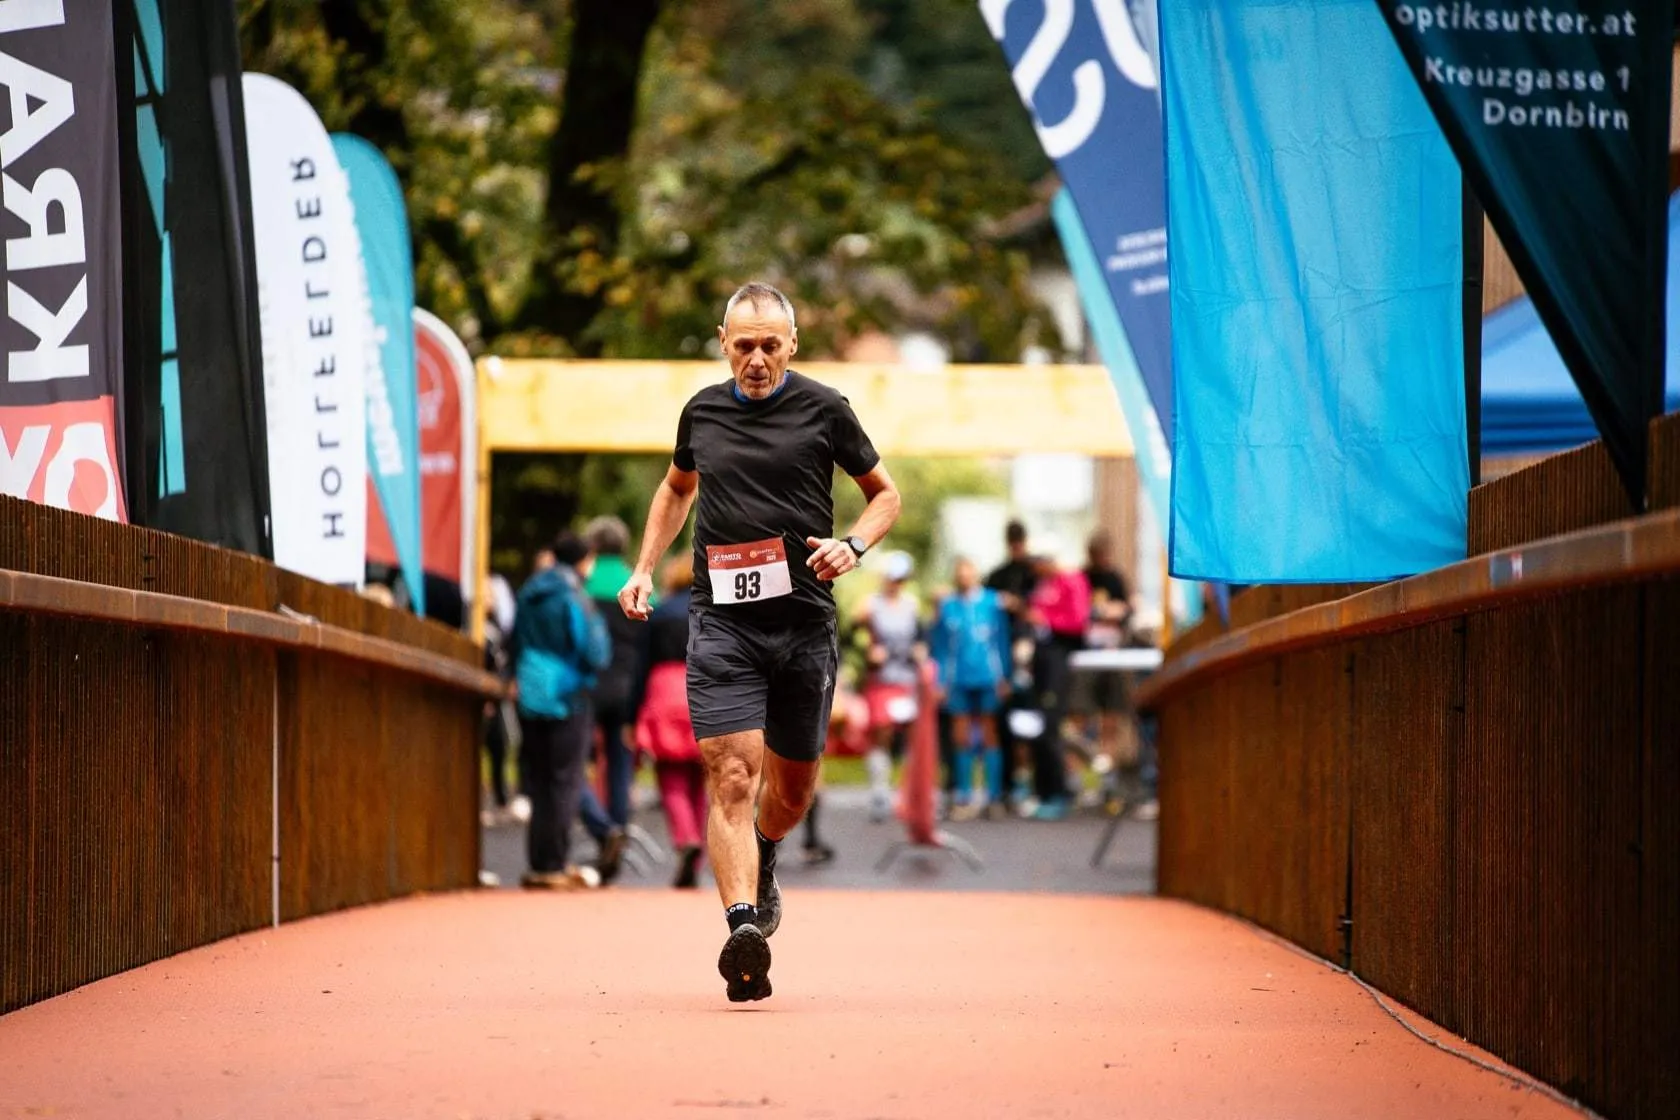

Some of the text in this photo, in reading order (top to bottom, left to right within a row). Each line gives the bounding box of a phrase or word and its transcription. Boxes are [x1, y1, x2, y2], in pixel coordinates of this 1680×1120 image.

[1396, 1, 1636, 37] optiksutter.at
[1424, 56, 1630, 95] Kreuzgasse 1
[1483, 98, 1629, 130] Dornbirn
[734, 571, 761, 600] 93
